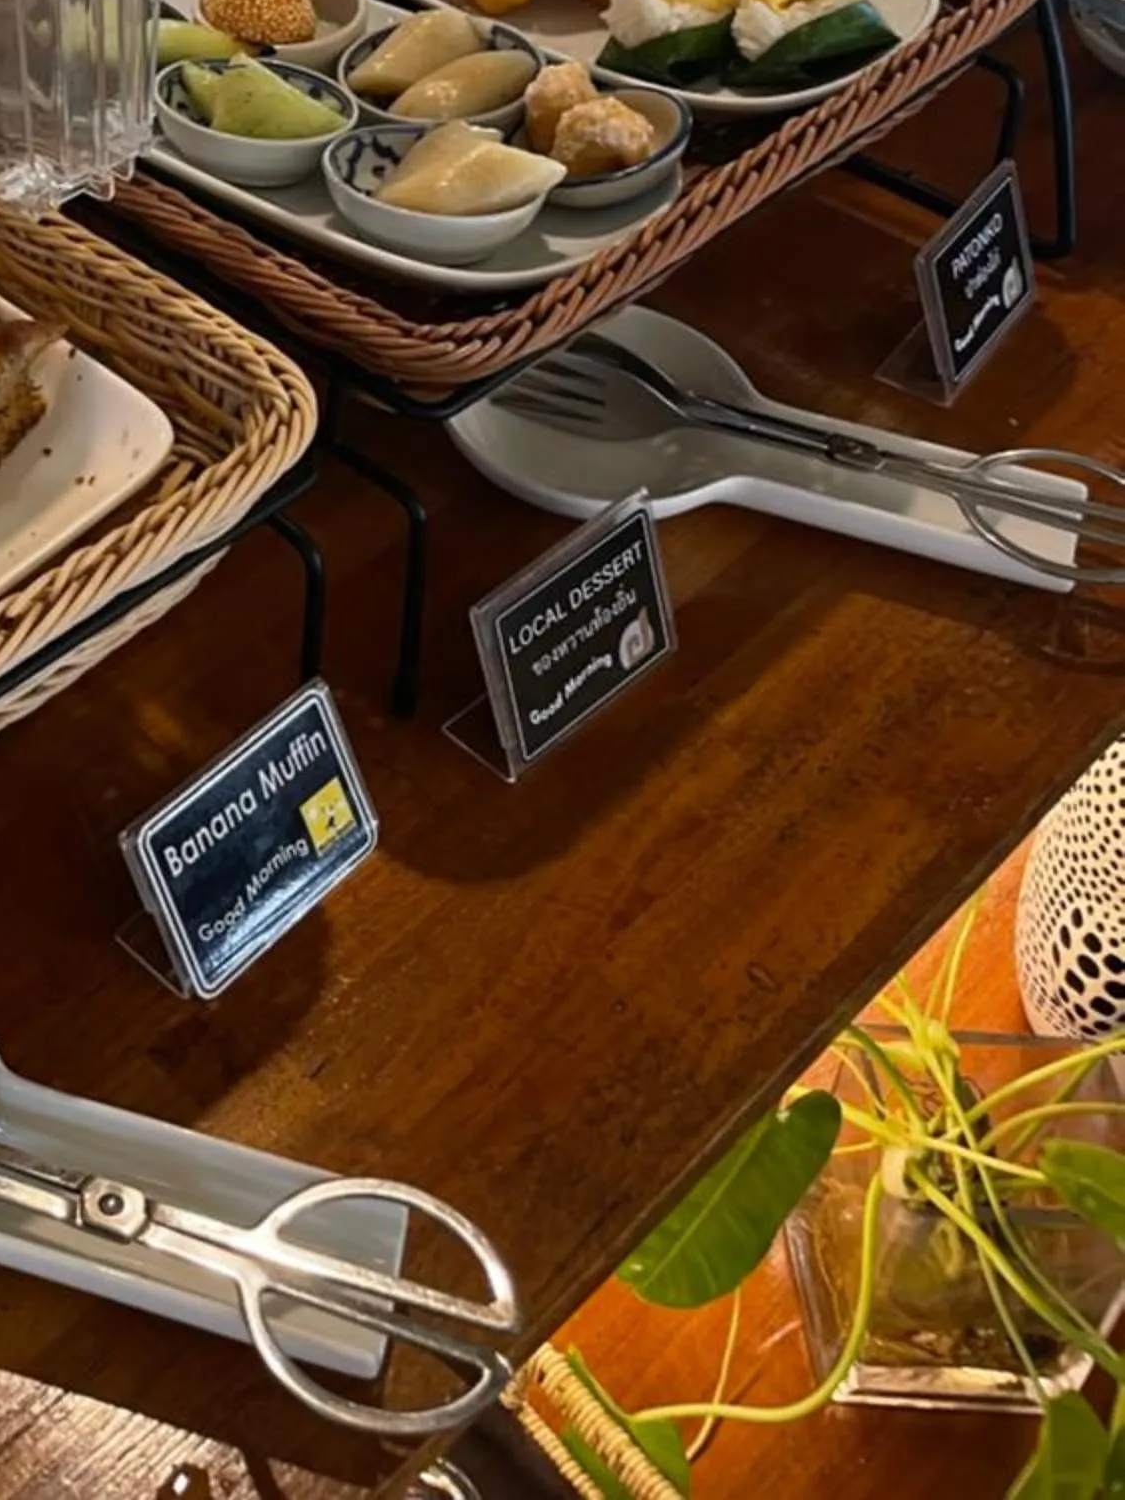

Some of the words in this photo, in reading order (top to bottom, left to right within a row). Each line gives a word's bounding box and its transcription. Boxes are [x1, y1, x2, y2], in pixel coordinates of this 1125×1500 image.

[507, 601, 568, 655] LOCAL
[568, 539, 644, 610] DESSERT
[529, 691, 564, 726] Good
[563, 653, 613, 700] Morning
[162, 788, 259, 878] Banana
[257, 731, 328, 800] Muffin
[197, 895, 246, 942] Good
[244, 838, 310, 902] Morning
